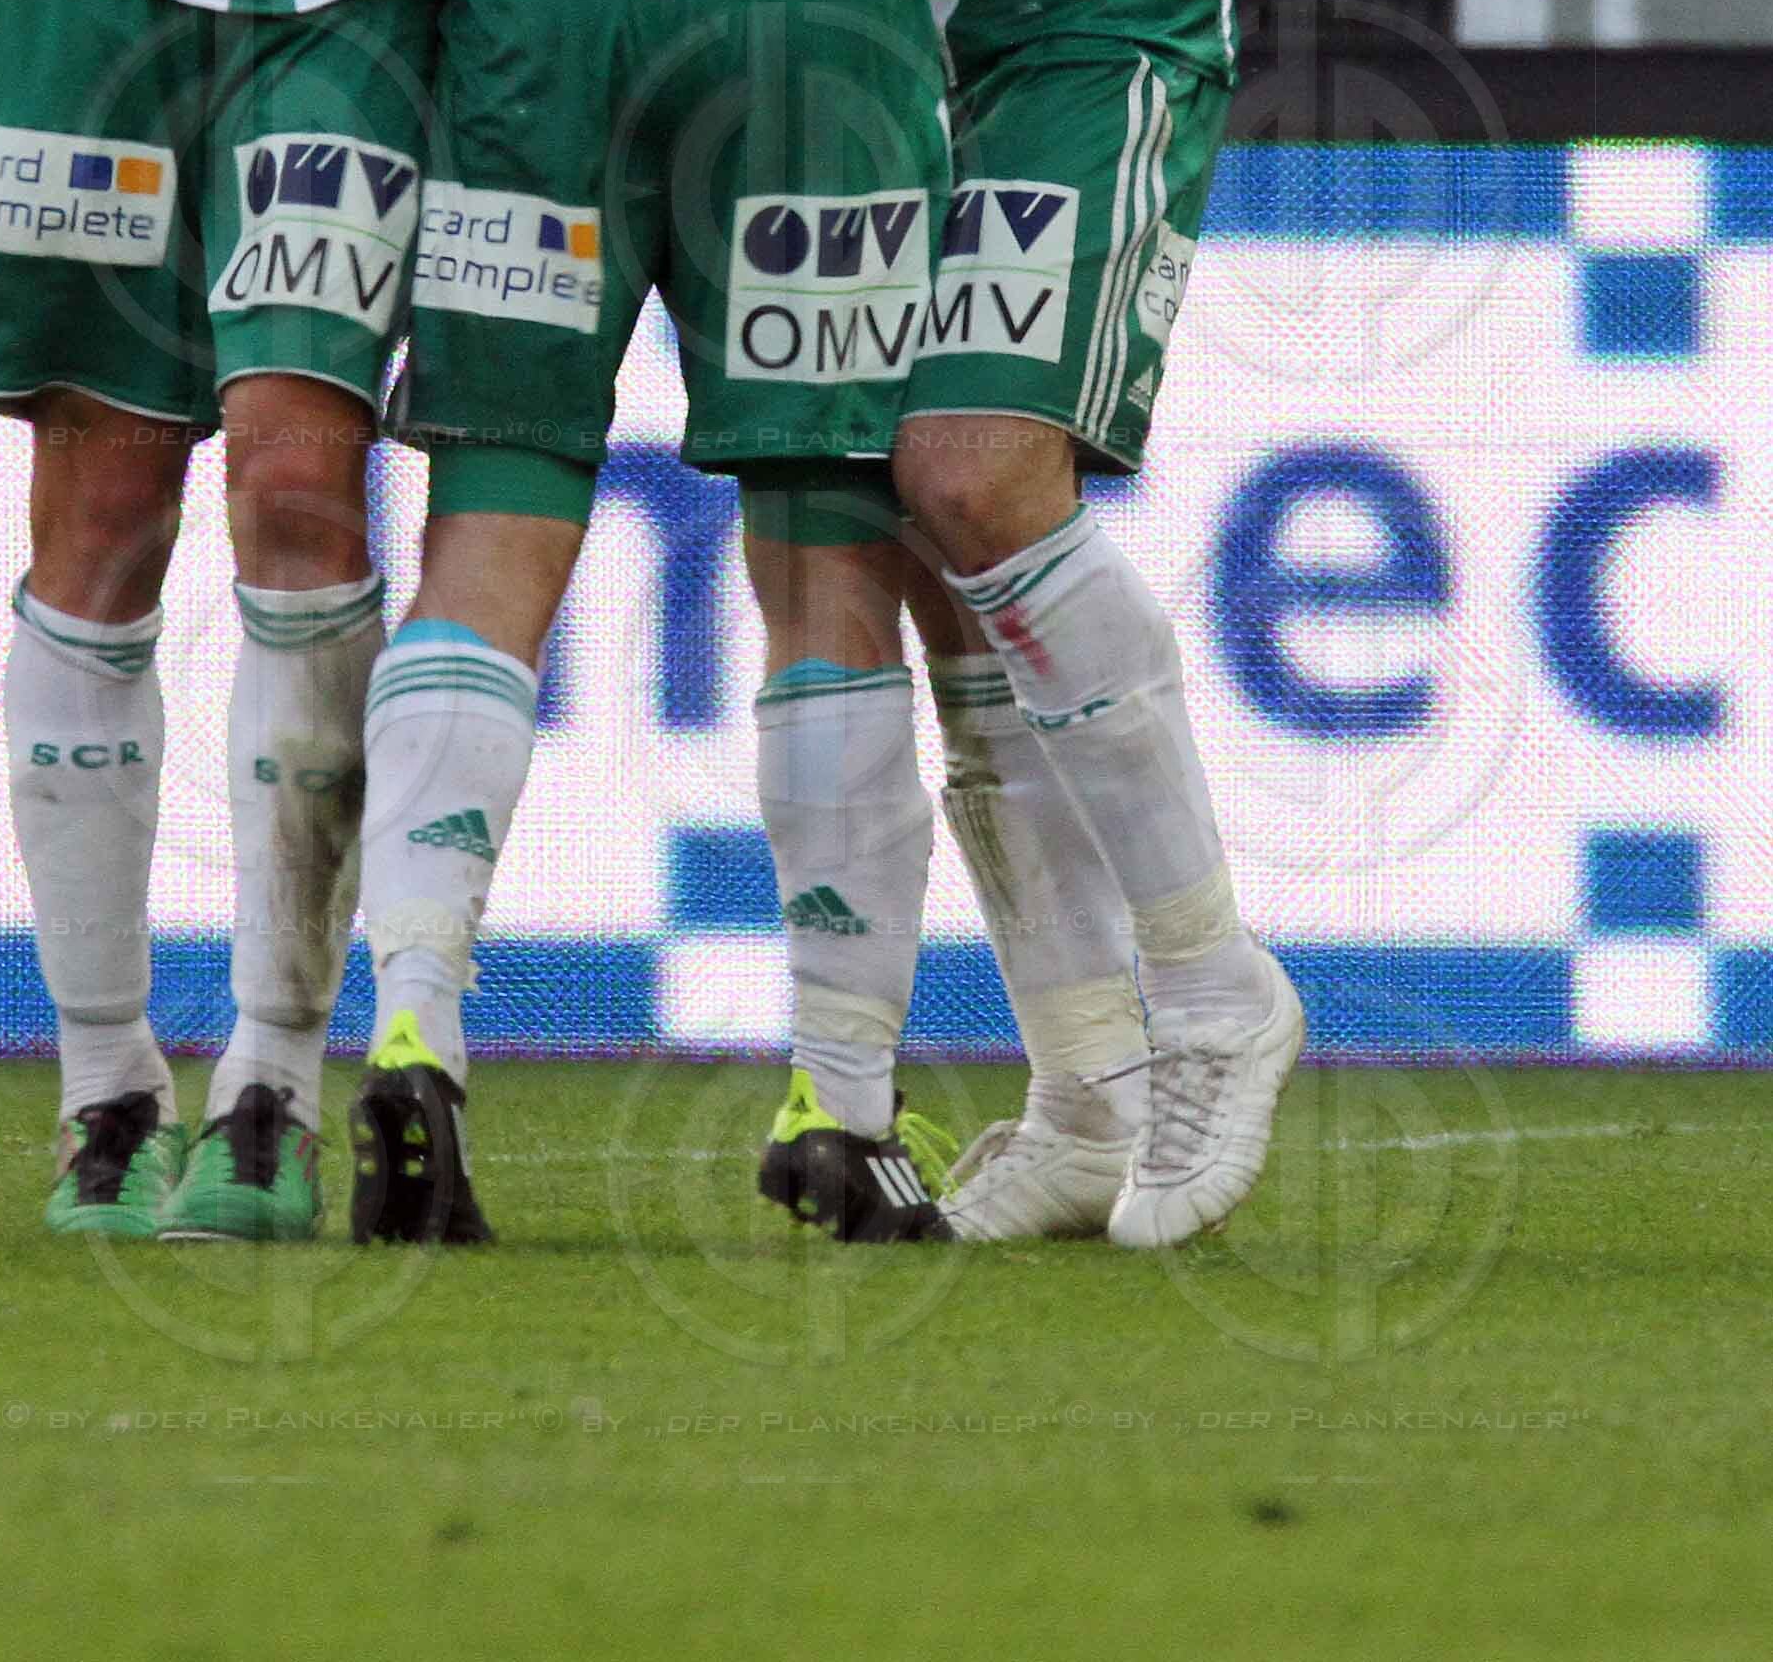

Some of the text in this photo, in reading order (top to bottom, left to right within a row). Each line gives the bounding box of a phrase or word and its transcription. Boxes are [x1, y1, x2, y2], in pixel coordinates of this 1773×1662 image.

[420, 201, 511, 244] card
[227, 234, 394, 312] OMV
[740, 301, 918, 373] OMV
[918, 281, 1054, 349] MV
[30, 739, 145, 769] SCR
